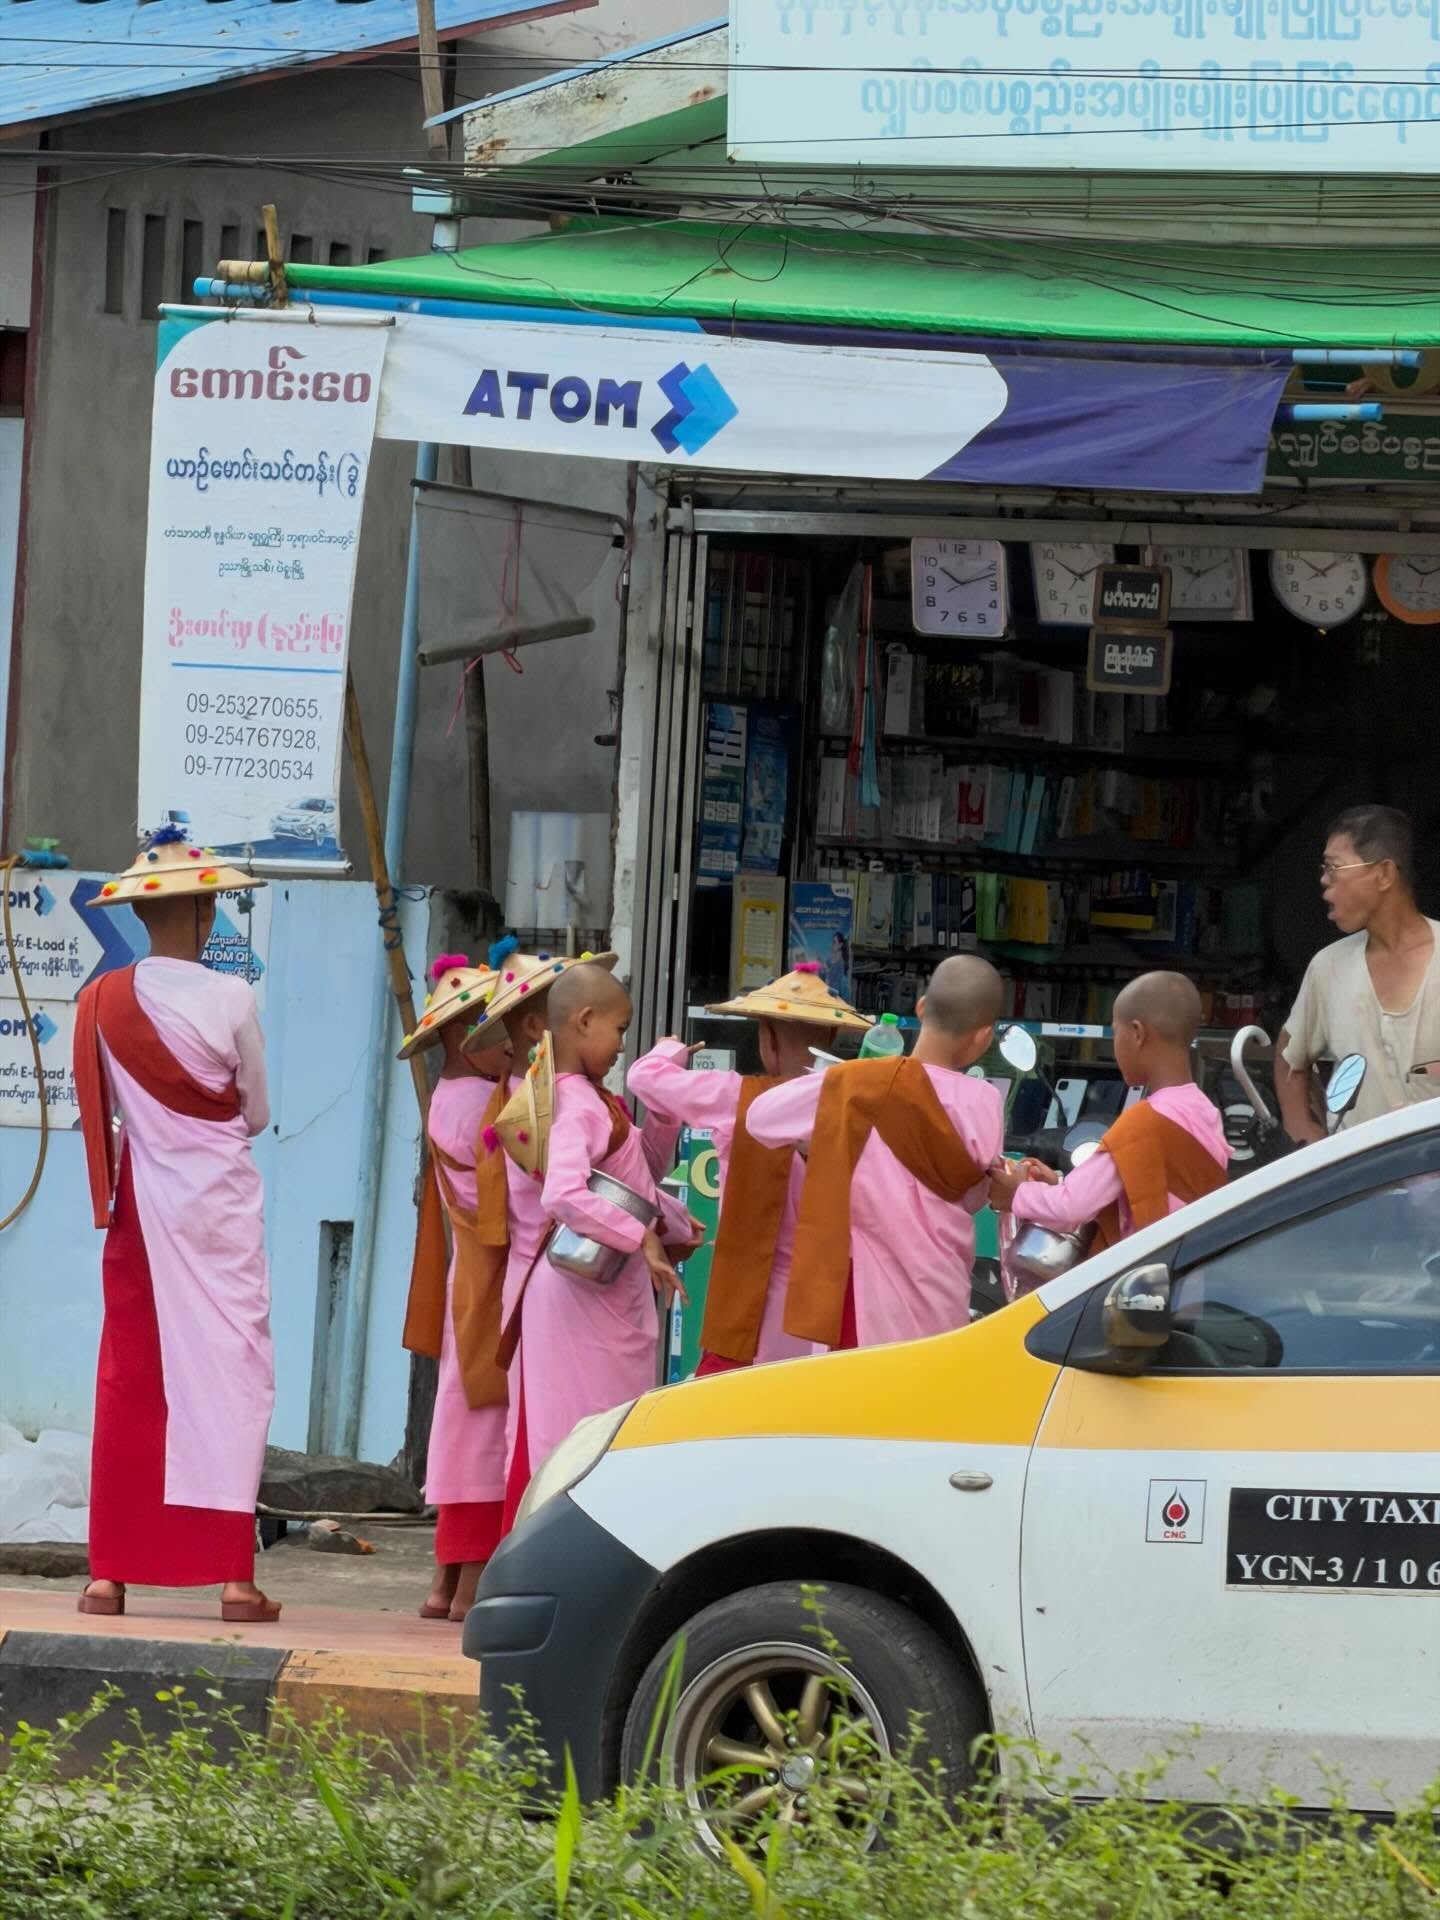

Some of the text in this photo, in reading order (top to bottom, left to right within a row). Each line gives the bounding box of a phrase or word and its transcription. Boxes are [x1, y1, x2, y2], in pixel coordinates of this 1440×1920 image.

[462, 369, 642, 428] ATOM
[186, 692, 322, 721] 09-253270655,
[185, 724, 320, 752] 09-254767928,
[184, 755, 314, 780] 09-777230534
[26, 937, 65, 951] E-Load
[201, 950, 233, 962] ATOM
[1265, 1494, 1440, 1524] CITY TAXI
[1163, 1530, 1186, 1540] CNG
